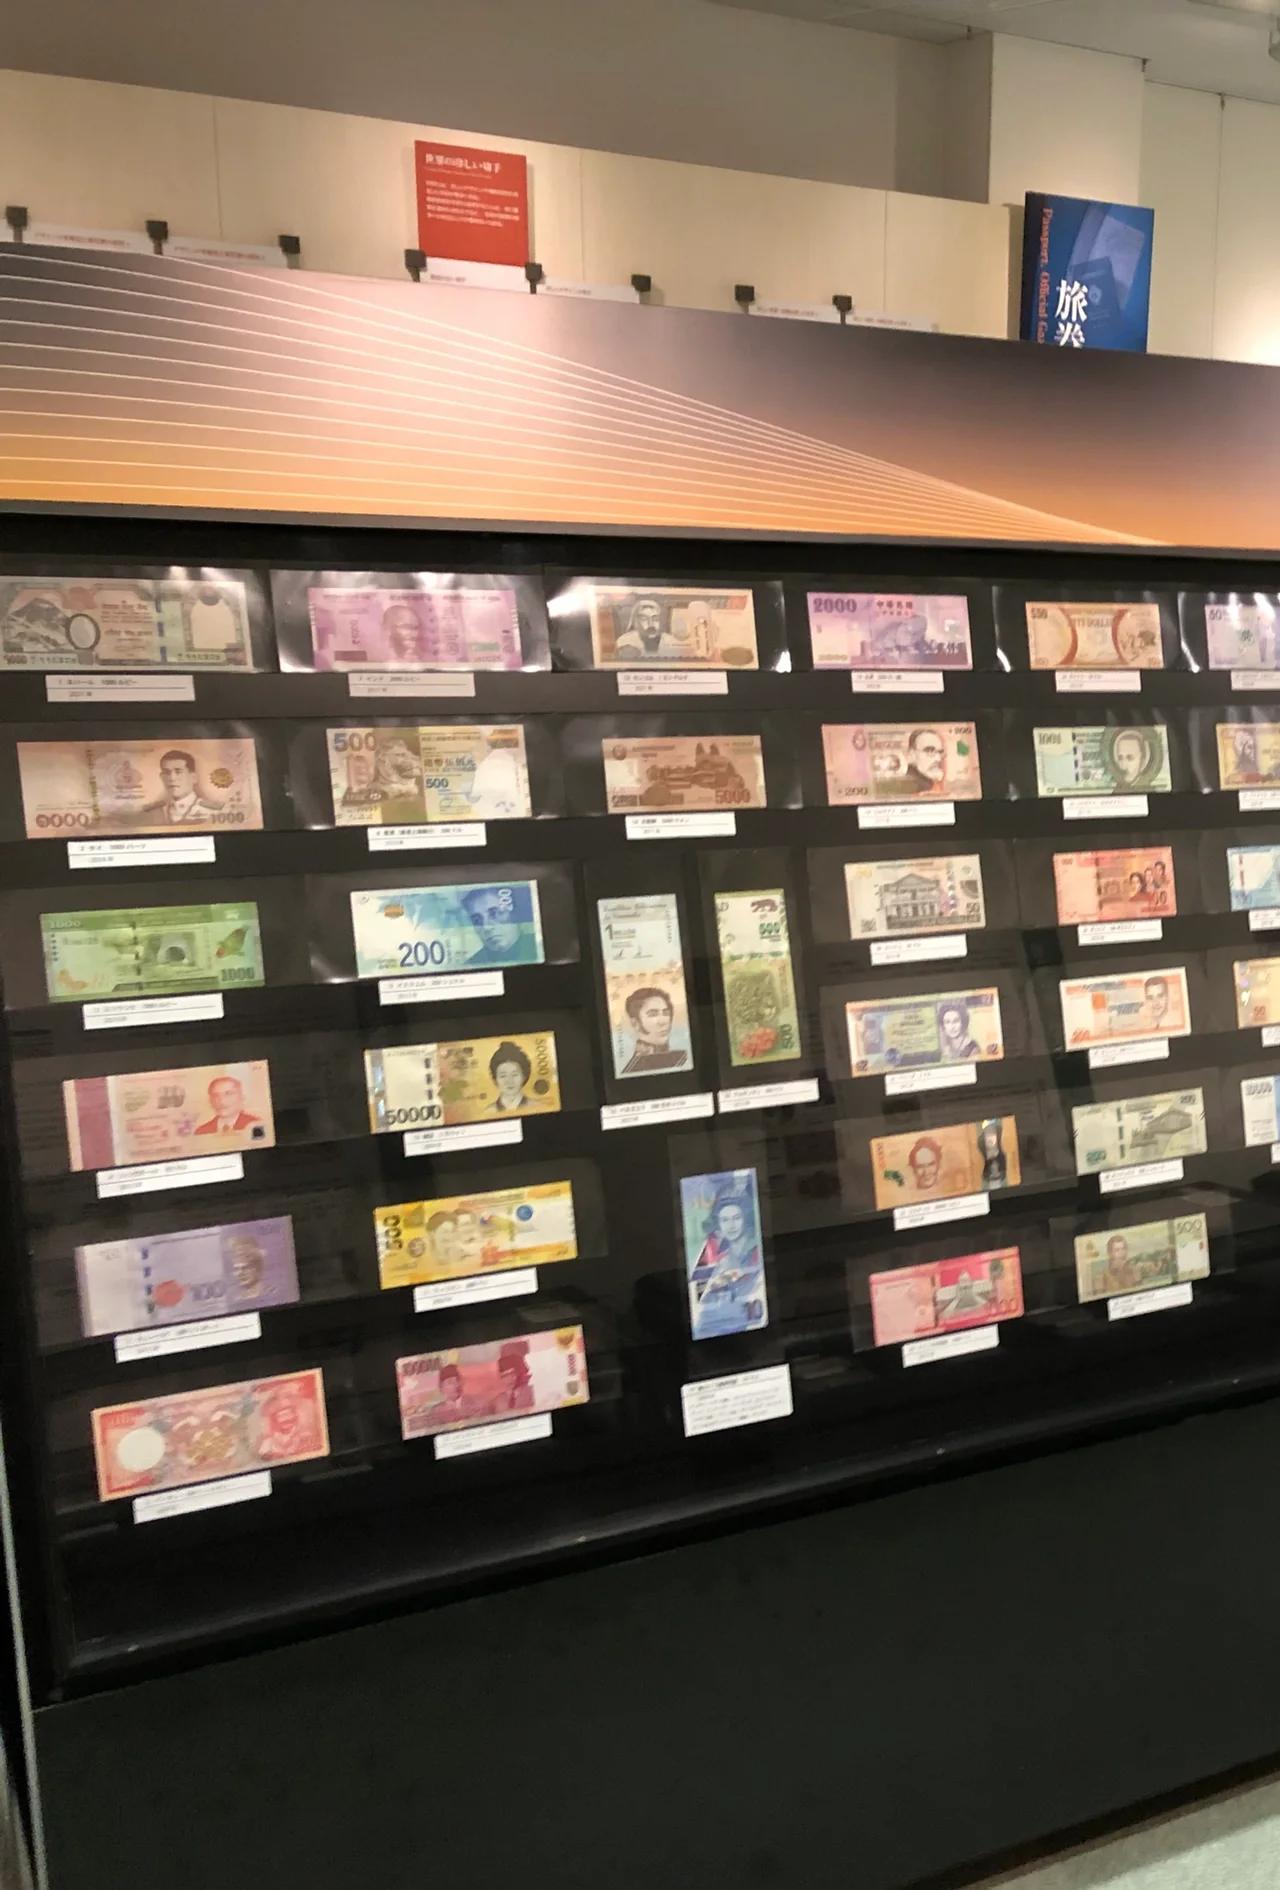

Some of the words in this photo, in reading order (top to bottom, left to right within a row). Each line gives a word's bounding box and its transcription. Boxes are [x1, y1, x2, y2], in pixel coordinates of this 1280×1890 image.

[813, 597, 857, 613] 2000
[333, 731, 376, 752] 500
[425, 777, 449, 789] 500
[498, 888, 513, 912] 200
[398, 940, 445, 968] 200
[385, 1105, 442, 1125] 50000
